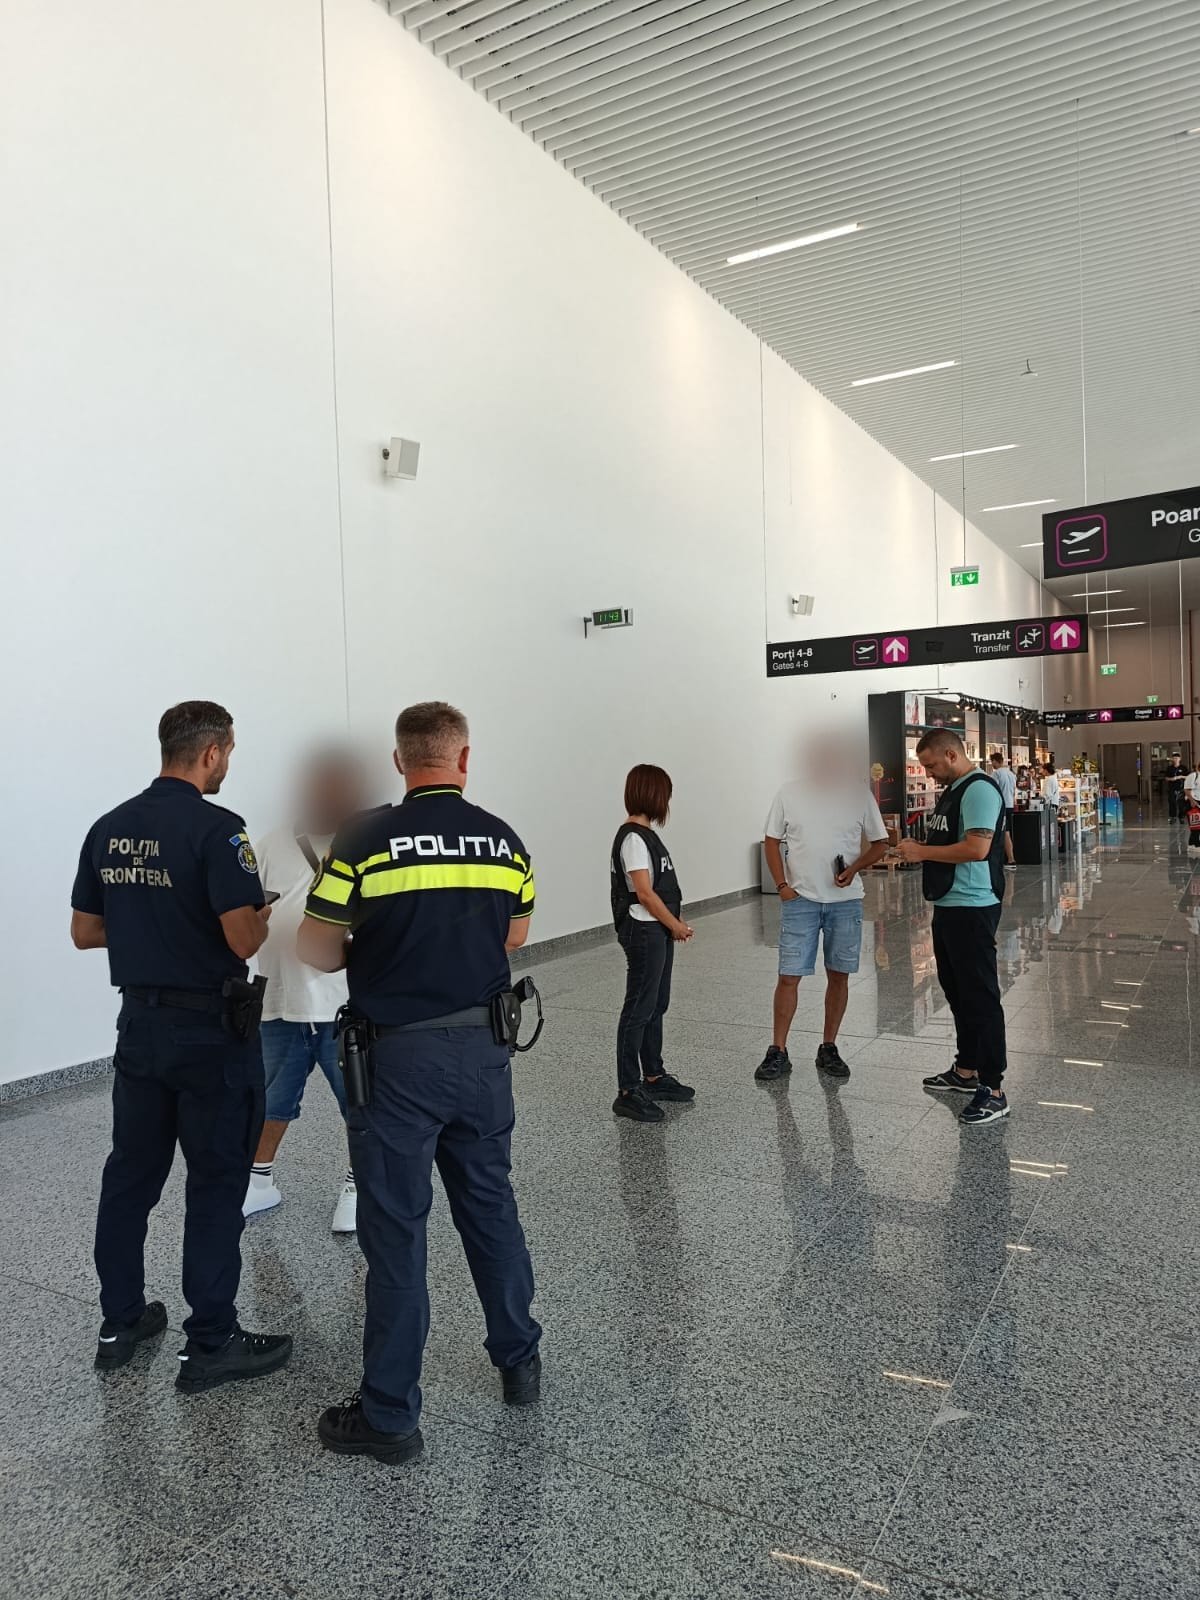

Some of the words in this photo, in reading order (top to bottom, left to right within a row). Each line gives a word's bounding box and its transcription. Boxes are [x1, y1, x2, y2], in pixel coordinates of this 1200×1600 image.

[970, 629, 1011, 643] Tranzit
[796, 648, 813, 658] 4-8
[973, 644, 1011, 654] Transfer
[389, 834, 513, 861] POLITIA
[133, 856, 144, 866] DE
